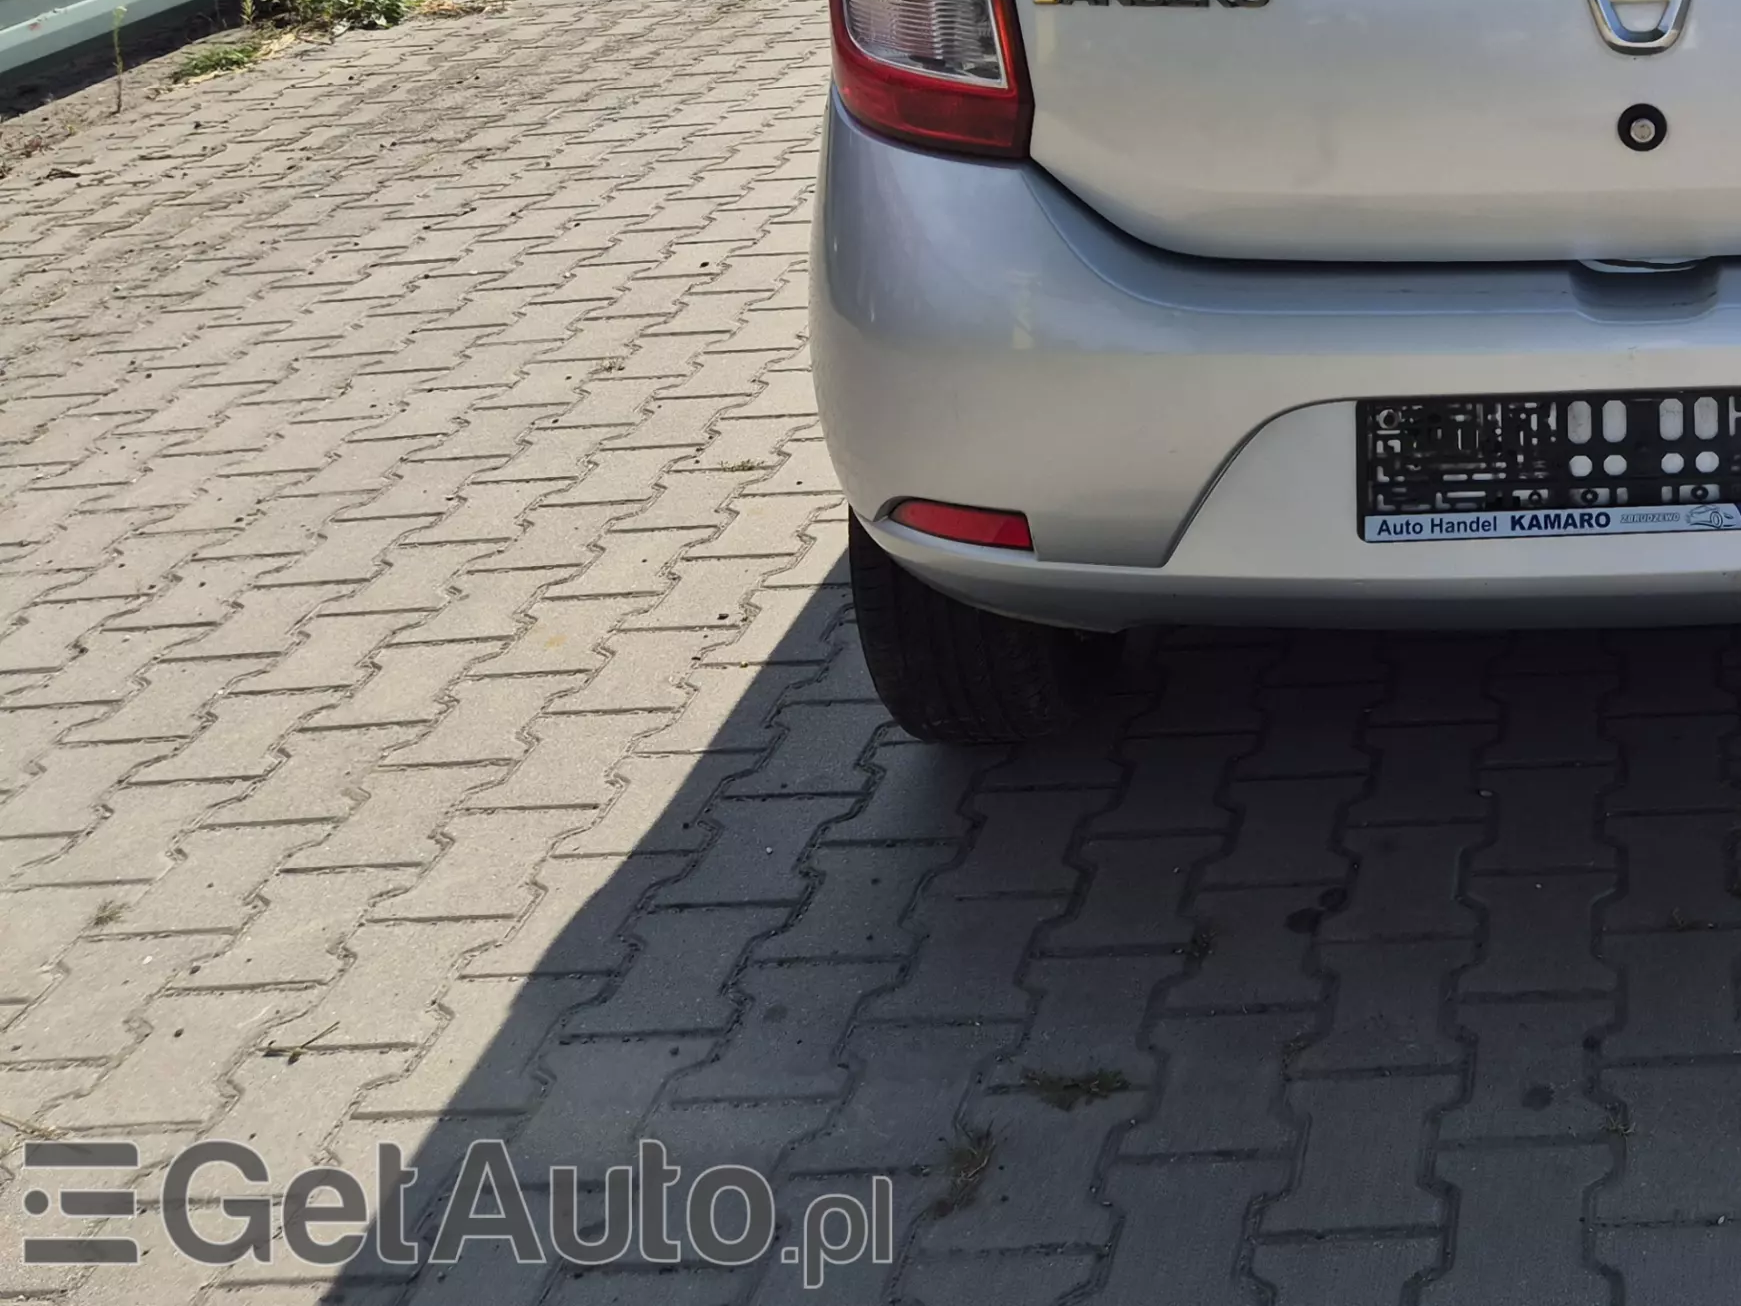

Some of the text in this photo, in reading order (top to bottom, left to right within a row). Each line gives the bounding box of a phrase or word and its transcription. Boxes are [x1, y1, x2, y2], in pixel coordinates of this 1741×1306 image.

[1377, 518, 1424, 536] Auto
[1430, 516, 1498, 535] Handel
[1510, 511, 1612, 532] KAMARO
